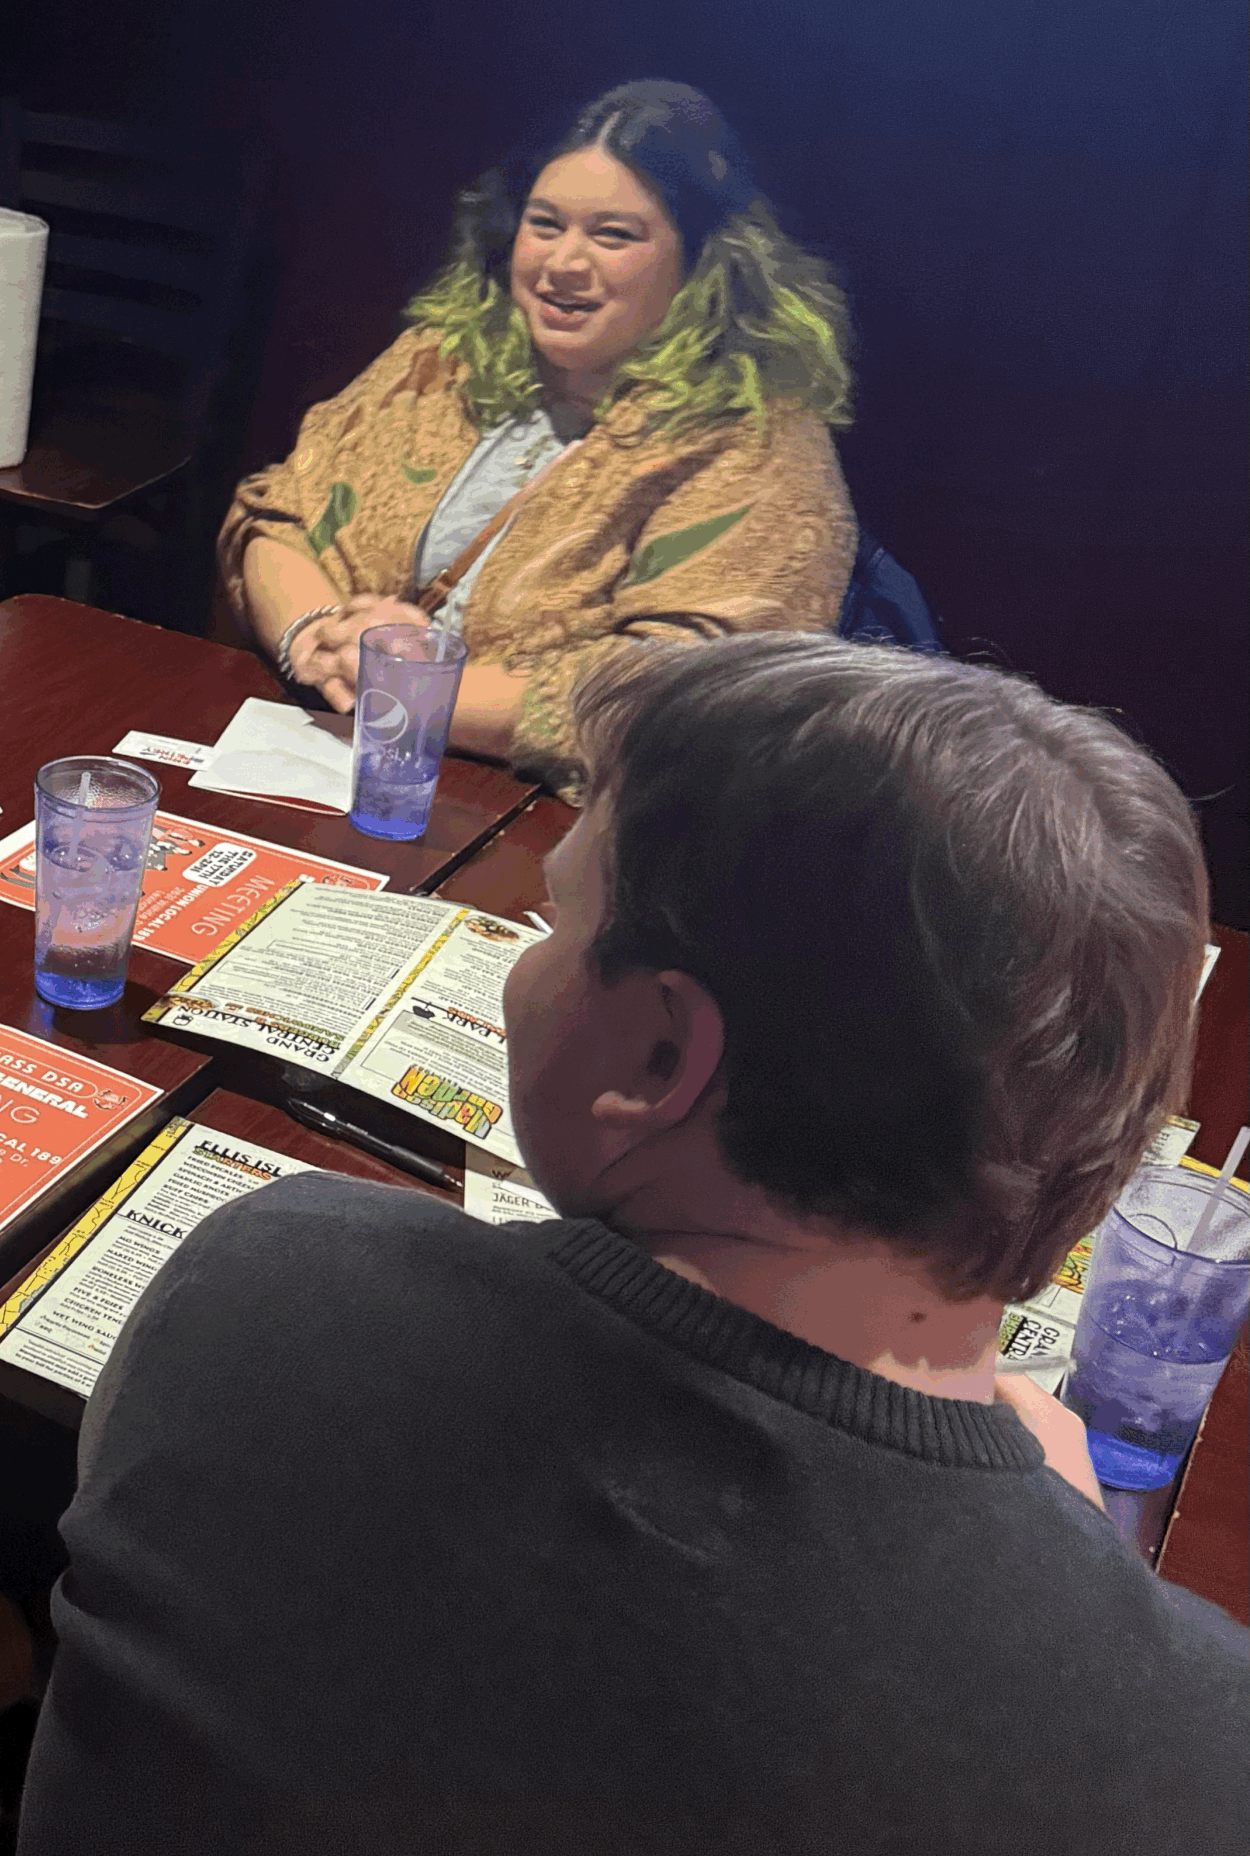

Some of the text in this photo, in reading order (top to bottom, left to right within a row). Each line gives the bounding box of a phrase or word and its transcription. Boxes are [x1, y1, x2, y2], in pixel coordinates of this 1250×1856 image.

[176, 884, 209, 907] UNION
[191, 874, 275, 936] MEETING
[148, 905, 182, 928] LOCAL
[178, 1005, 250, 1028] STATION
[442, 1012, 491, 1038] PARK
[257, 1024, 340, 1056] CENTRAL
[266, 1036, 330, 1063] GRAND
[41, 1070, 84, 1093] DSA
[30, 1147, 64, 1166] 189
[193, 1146, 274, 1181] STARTERS
[199, 1140, 252, 1166] ELLIS
[126, 1209, 188, 1239] KNICK
